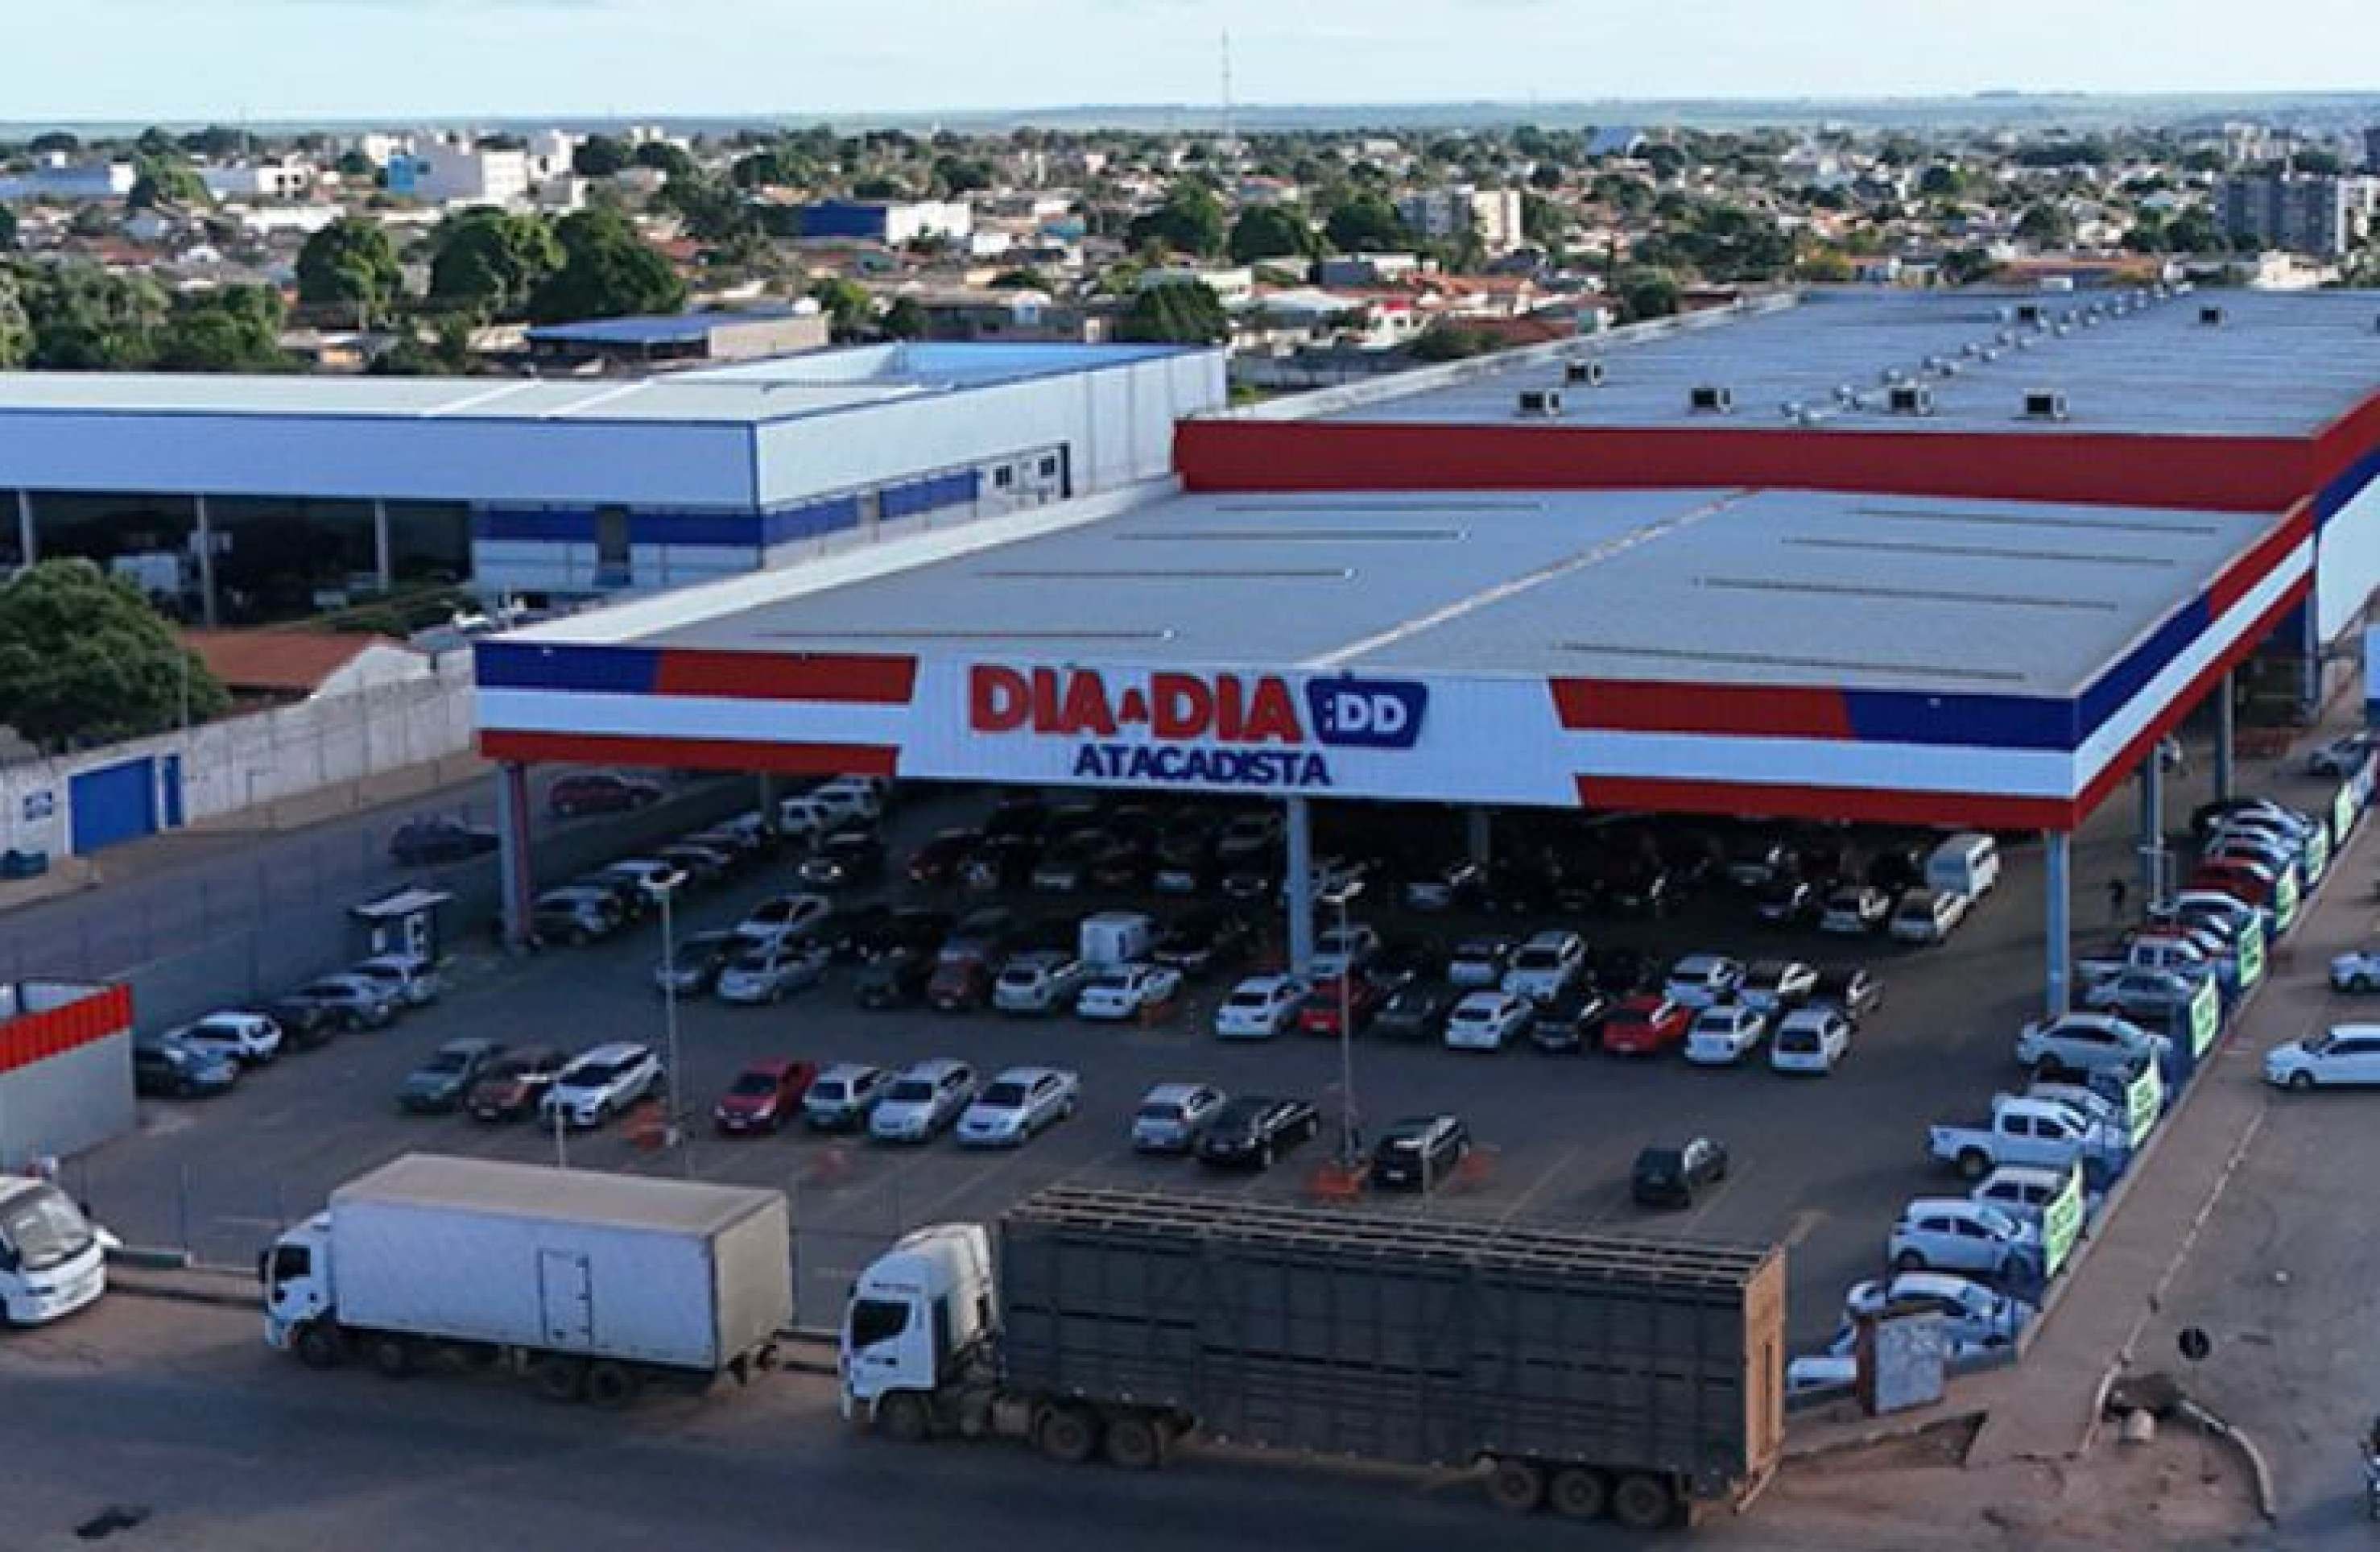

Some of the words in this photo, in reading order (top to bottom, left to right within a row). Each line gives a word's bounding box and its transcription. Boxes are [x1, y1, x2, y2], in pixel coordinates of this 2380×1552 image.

[970, 664, 1118, 735] DIA
[1118, 689, 1151, 724] A
[1151, 672, 1304, 744] DIA
[1073, 743, 1333, 787] ATACADISTA
